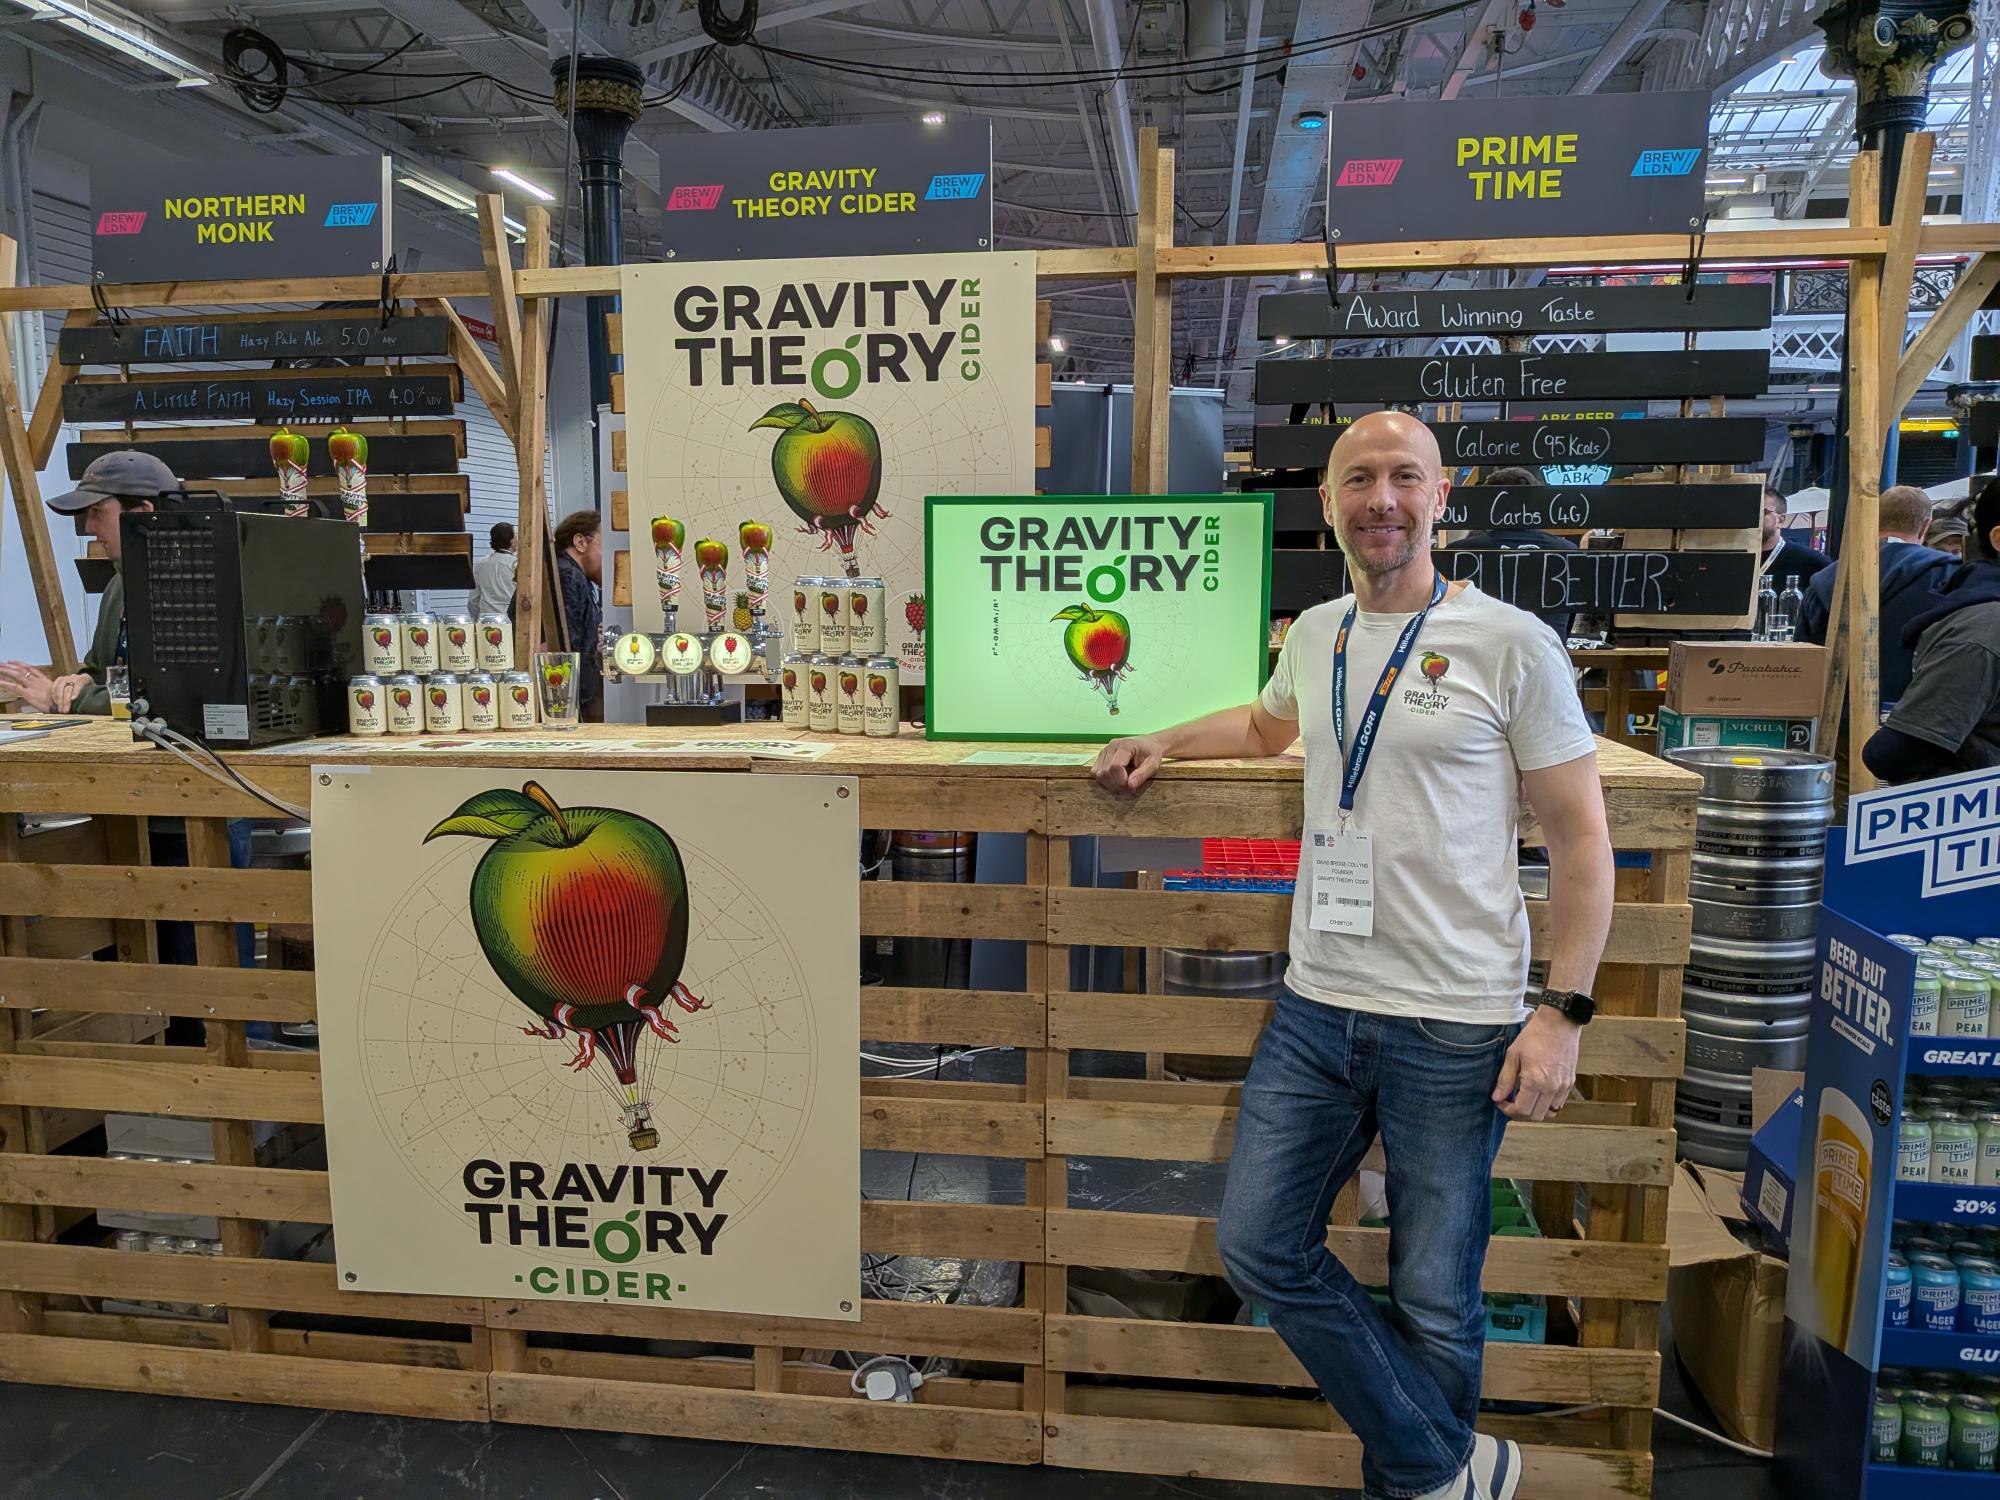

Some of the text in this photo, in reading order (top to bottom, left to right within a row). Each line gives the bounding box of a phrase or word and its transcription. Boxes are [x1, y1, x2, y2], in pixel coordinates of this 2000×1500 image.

[1457, 134, 1578, 167] PRIME
[1643, 152, 1684, 164] BREW
[1348, 161, 1387, 173] BREW
[1642, 163, 1673, 174] LDN
[769, 168, 878, 192] GRAVITY
[935, 177, 970, 188] BREW
[1348, 173, 1376, 184] LDN
[1469, 170, 1562, 200] TIME
[675, 188, 711, 199] BREW
[935, 187, 962, 198] LDN
[165, 194, 306, 219] NORTHERN
[333, 205, 366, 215] BREW
[675, 198, 702, 209] LDN
[732, 192, 917, 219] THEORY CIDER
[104, 214, 135, 224] BREW
[333, 215, 357, 225] LDN
[104, 223, 128, 233] LDN
[197, 221, 275, 245] MONK
[673, 279, 958, 333] GRAVITY
[1441, 302, 1523, 329] Winning
[1541, 297, 1596, 323] Taste
[960, 277, 981, 382] CIDER
[143, 326, 218, 356] FAITH
[240, 334, 269, 350] Hazy
[275, 333, 298, 347] Pale
[304, 332, 323, 346] Ale
[674, 331, 957, 400] THEORY
[1420, 357, 1567, 398] Gluten Free
[135, 391, 147, 410] A
[268, 393, 295, 411] Hazy
[300, 390, 341, 406] Session
[346, 388, 373, 406] IPA
[1456, 426, 1521, 457] Calorie
[1562, 472, 1593, 485] ABK
[1490, 491, 1542, 526] Carbs
[980, 515, 1203, 551] GRAVITY
[1202, 514, 1221, 592] CIDER
[980, 554, 1201, 604] THEORY
[1541, 552, 1669, 611] BETTER.
[1398, 613, 1423, 654] Hillebrand
[902, 649, 925, 657] THEO
[1403, 696, 1448, 711] THEORY
[1404, 689, 1450, 703] GRAVITY
[1731, 723, 1783, 733] VICRILA
[1347, 711, 1377, 788] Hillebrand GORI
[1868, 786, 2000, 841] PRIM
[1947, 835, 2000, 872] TI
[1829, 937, 1887, 991] BEER. BUT
[1820, 960, 1894, 1047] BETTER.
[1913, 995, 1932, 1004] IME
[1950, 995, 1985, 1007] PRIME
[1912, 1021, 1931, 1030] EAR
[1956, 1022, 1983, 1033] PEAR
[1923, 1049, 1992, 1066] GREAT
[1871, 1093, 1892, 1117] taste
[1913, 1151, 1929, 1160] TIM
[1935, 1143, 1969, 1152] PRIME
[1823, 1149, 1855, 1172] PRIME
[1902, 1166, 1926, 1176] PEAR
[1941, 1166, 1969, 1178] PEAR
[462, 1158, 729, 1208] GRAVITY
[1836, 1173, 1862, 1200] TIME
[1953, 1199, 1997, 1215] 30%
[464, 1202, 729, 1264] THEORY
[528, 1266, 673, 1301] CIDER
[1973, 1317, 2000, 1330] LAGE
[1959, 1348, 2000, 1362] GLU
[1880, 1447, 1895, 1457] IPA
[1921, 1449, 1938, 1461] IPA
[1979, 1455, 1994, 1466] IPA
